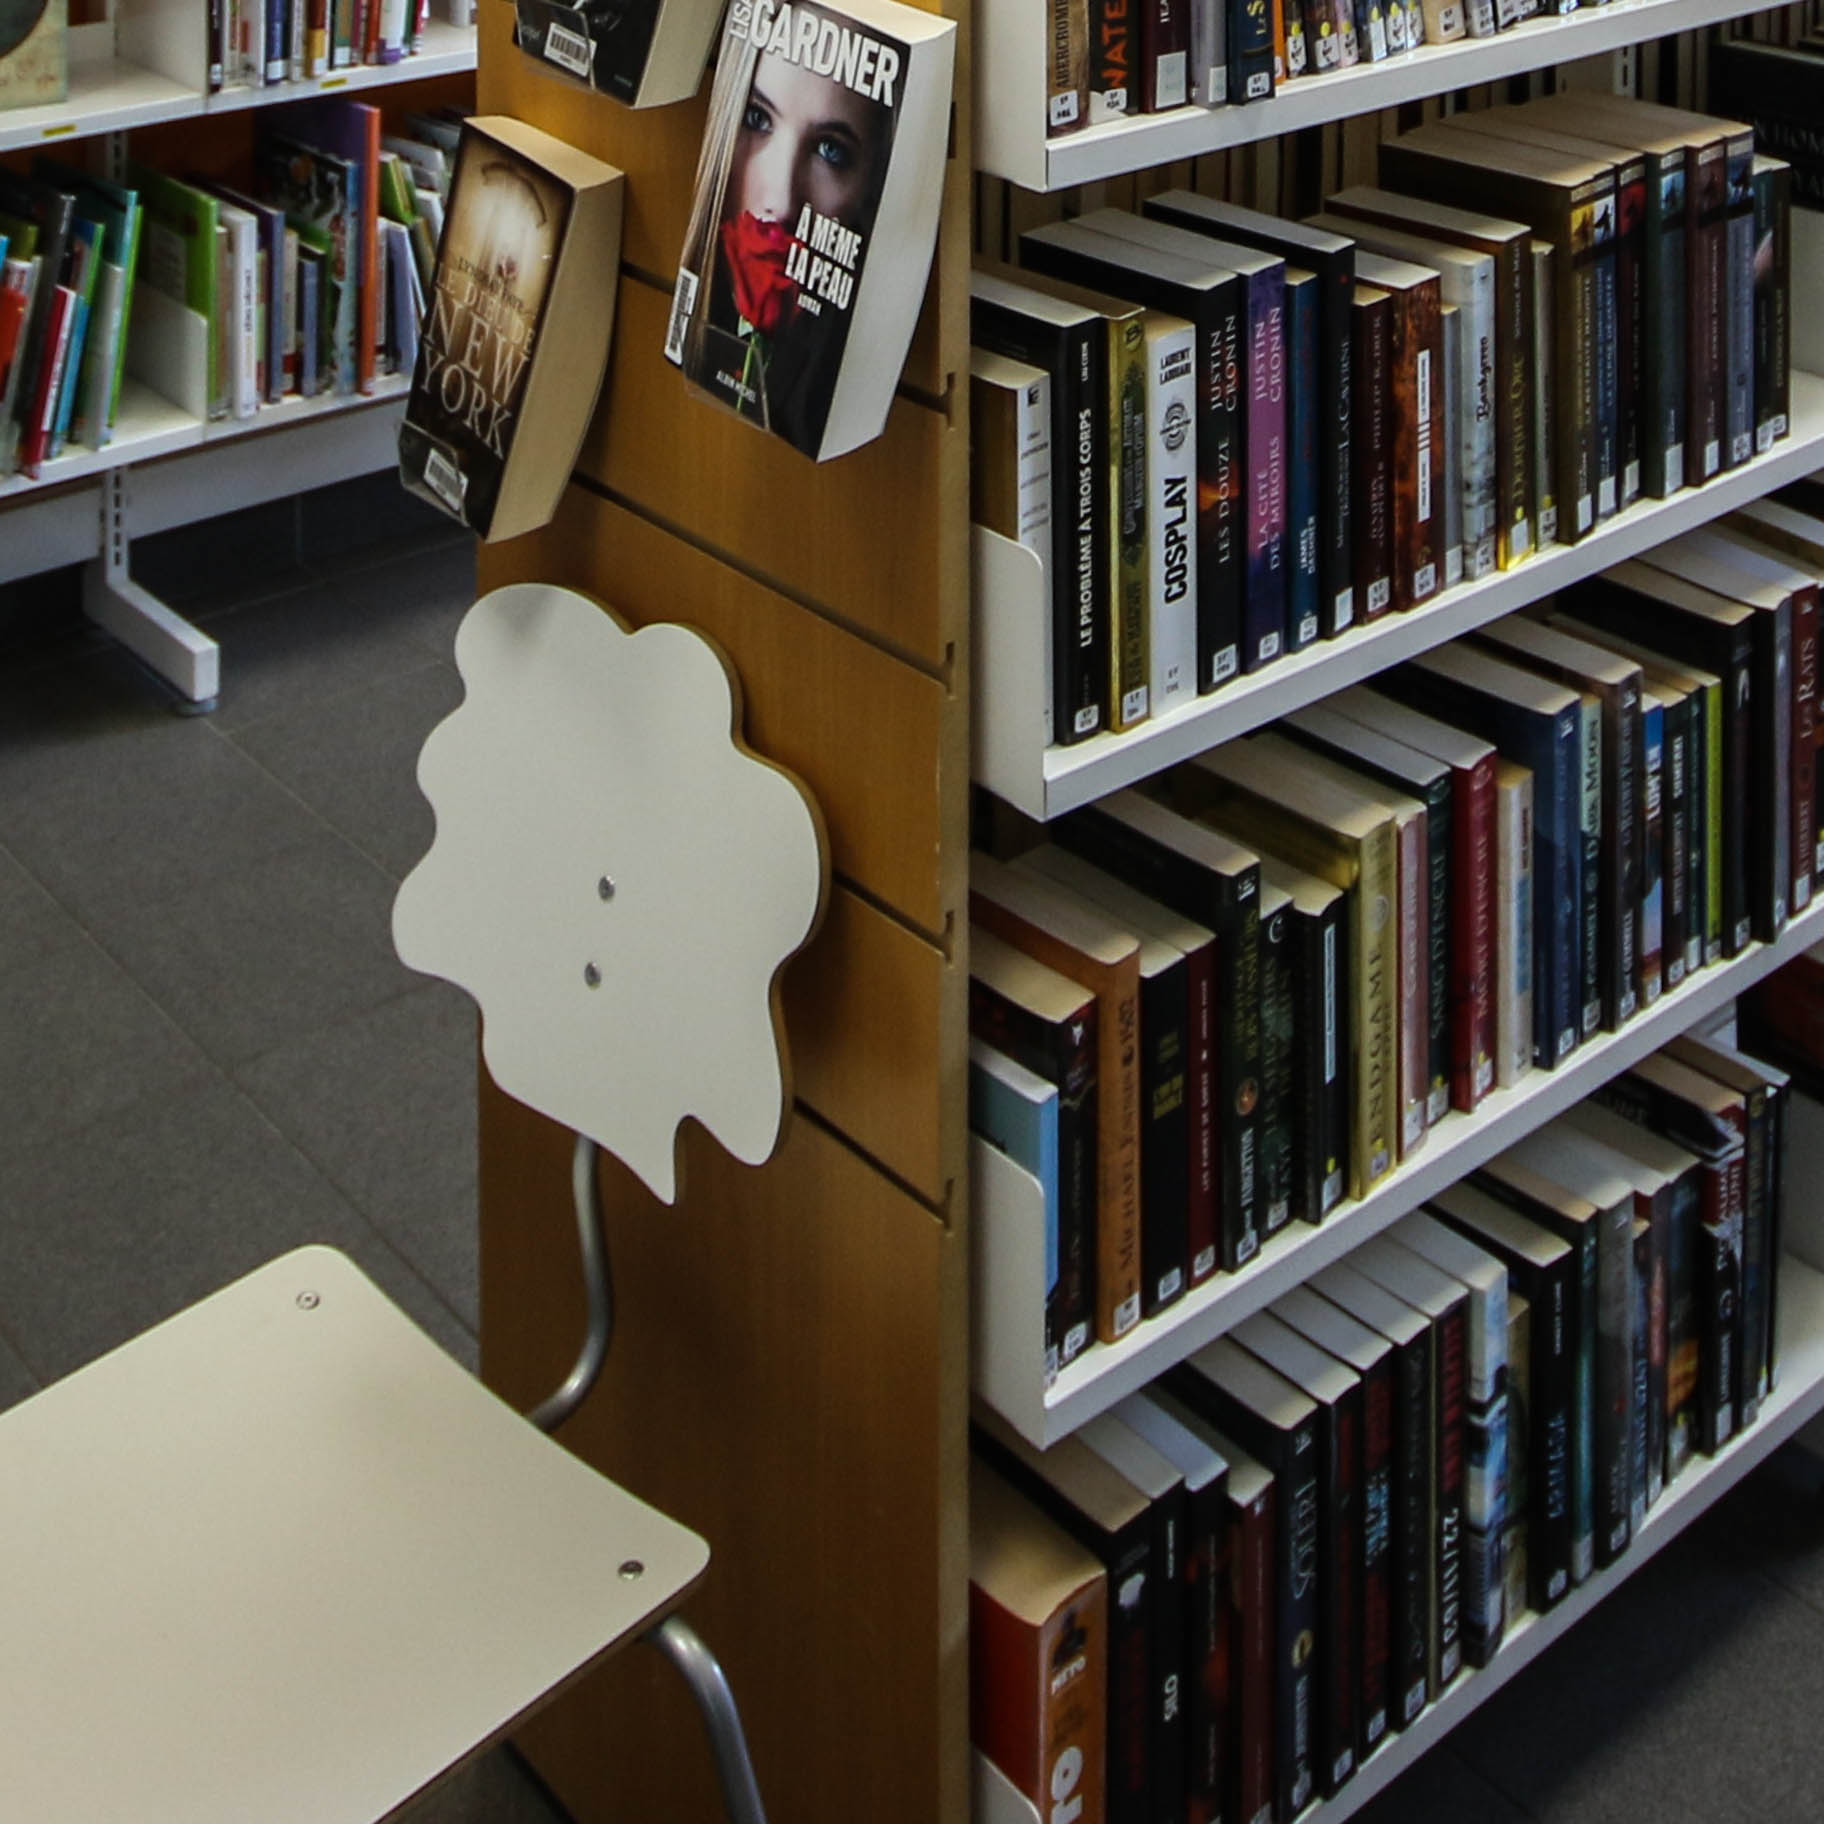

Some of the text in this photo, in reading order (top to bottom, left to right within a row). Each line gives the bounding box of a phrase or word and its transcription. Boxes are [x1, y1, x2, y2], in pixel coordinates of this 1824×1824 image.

[784, 241, 854, 312] LA PEAU
[809, 214, 863, 272] MÊME
[425, 285, 530, 406] NEW
[1209, 329, 1224, 412] JUSTIN
[1224, 313, 1239, 413] CRONIN
[1254, 319, 1269, 402] JUSTIN
[1269, 305, 1284, 403] CRONIN
[420, 339, 513, 462] YORK
[1076, 408, 1093, 647] LE PROBLÈME À TROIS CORPS
[1163, 473, 1190, 605] COSPLAY
[1217, 434, 1232, 564] LES DOUZE
[1255, 470, 1271, 548] LA CITÉ
[1268, 434, 1283, 571] DES MIROIRS
[1798, 635, 1816, 702] RATS
[1583, 718, 1600, 793] MOON
[1584, 797, 1600, 859] DARK
[1367, 945, 1385, 1140] ENDGAME
[1440, 1507, 1461, 1645] 22/11/63
